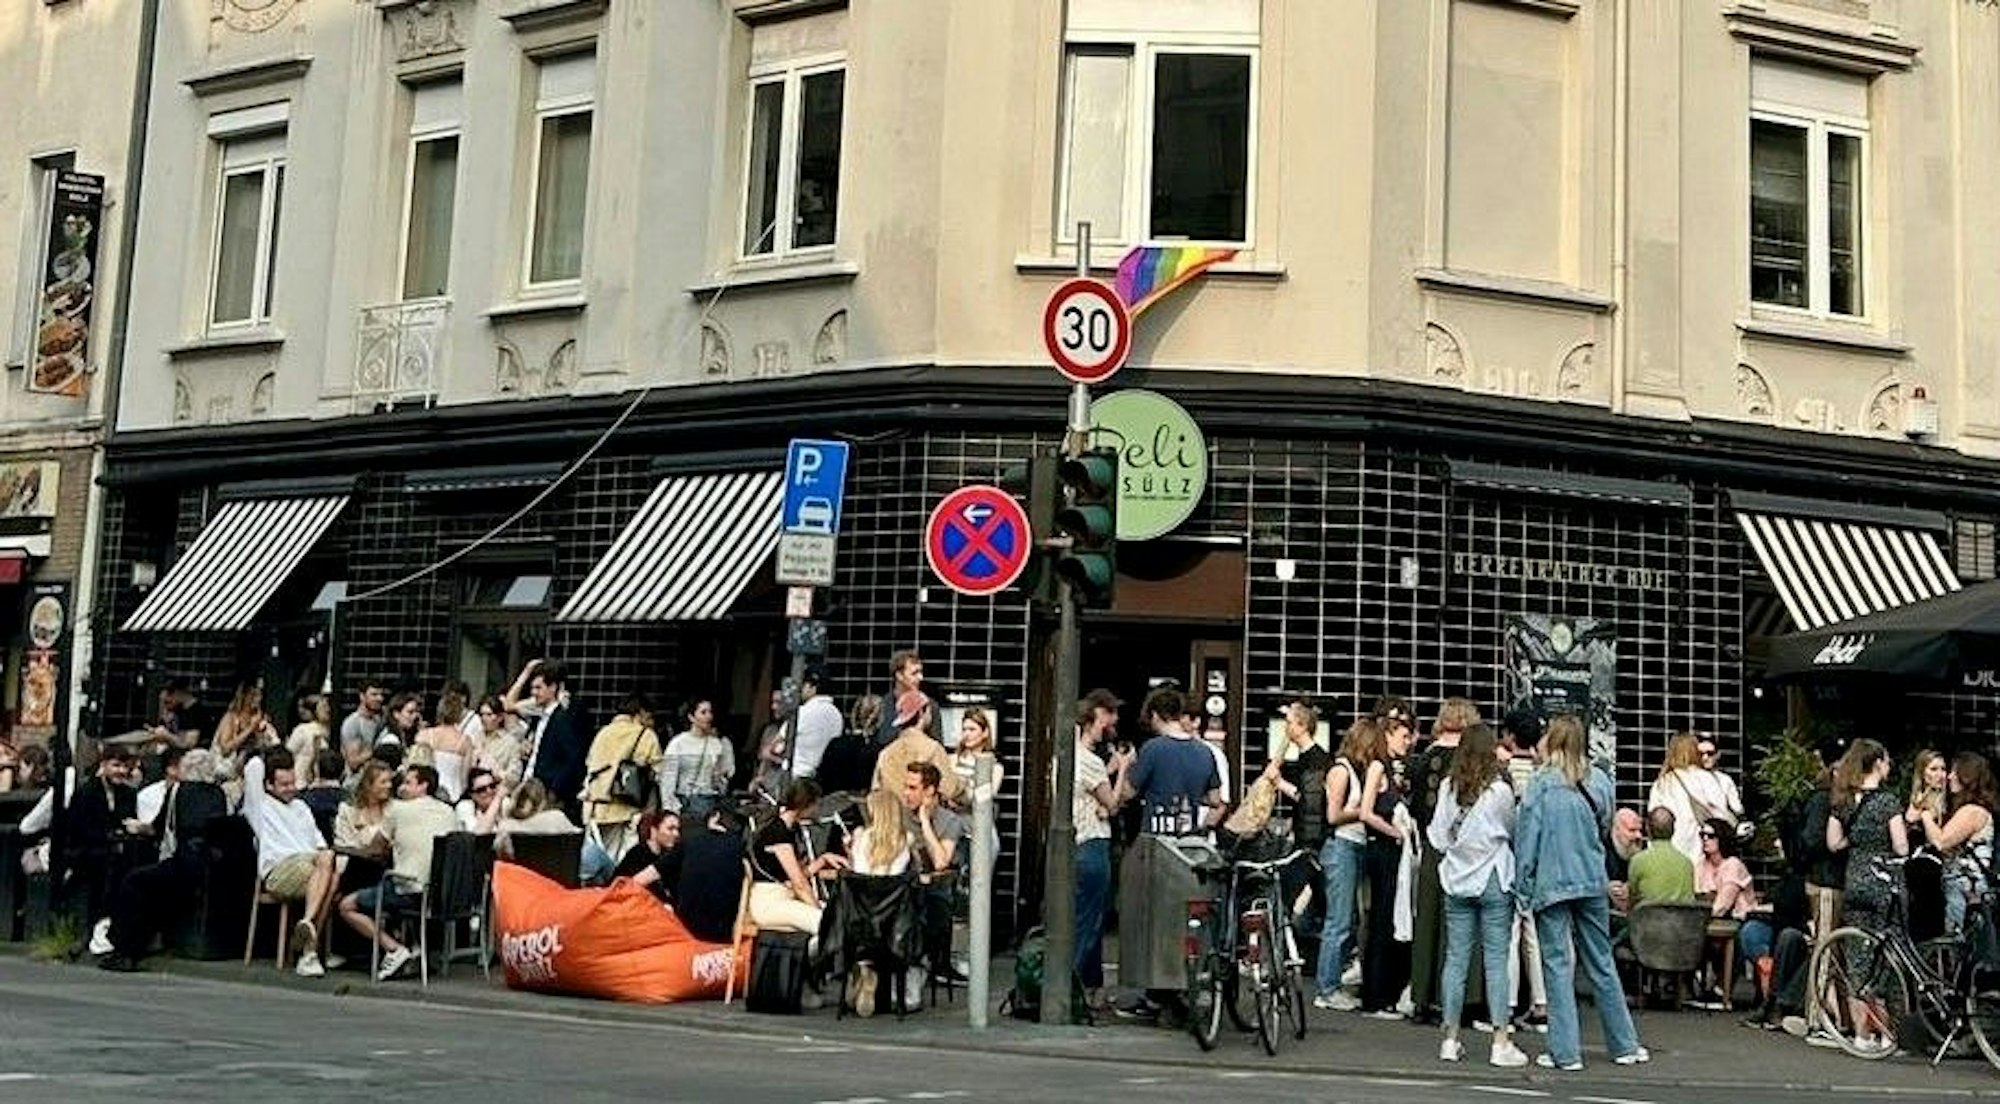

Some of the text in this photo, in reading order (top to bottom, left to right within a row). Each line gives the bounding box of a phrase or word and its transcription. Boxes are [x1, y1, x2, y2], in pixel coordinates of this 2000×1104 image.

[1062, 306, 1110, 352] 30
[794, 446, 823, 486] P
[1123, 472, 1191, 494] SÜLZ
